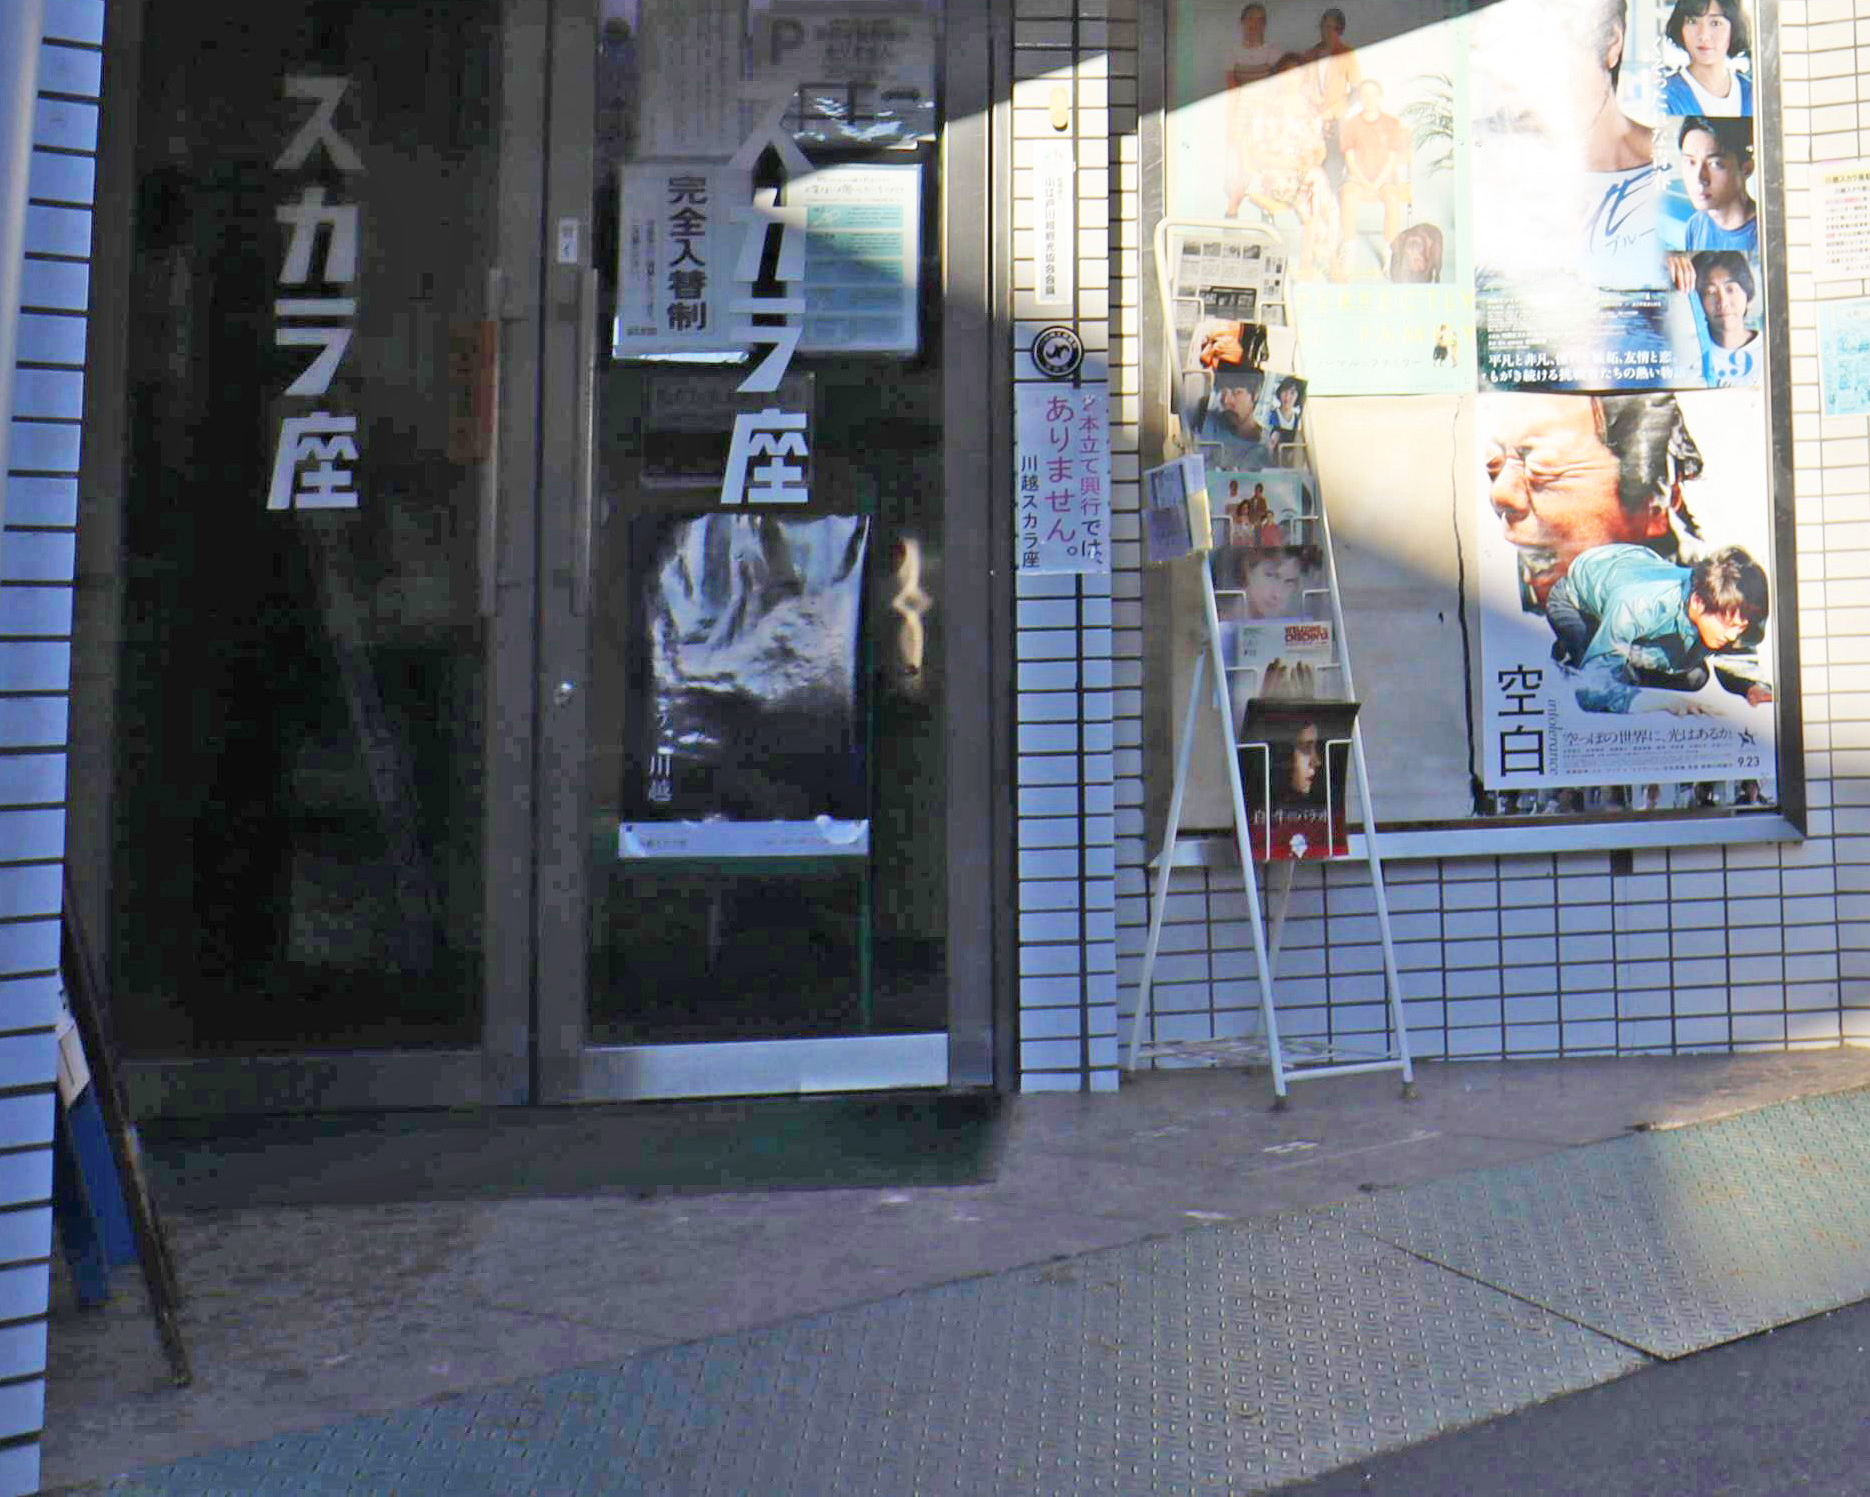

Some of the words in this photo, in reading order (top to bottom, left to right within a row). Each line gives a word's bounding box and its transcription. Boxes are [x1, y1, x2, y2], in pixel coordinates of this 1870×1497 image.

[266, 73, 366, 511] スカラ座
[667, 175, 708, 332] 完全入替制
[721, 82, 813, 505] スカラ座
[1022, 455, 1041, 569] 川越スカラ座
[1045, 397, 1079, 558] ありません。
[1497, 664, 1545, 777] 空白
[1737, 756, 1760, 768] 9.23
